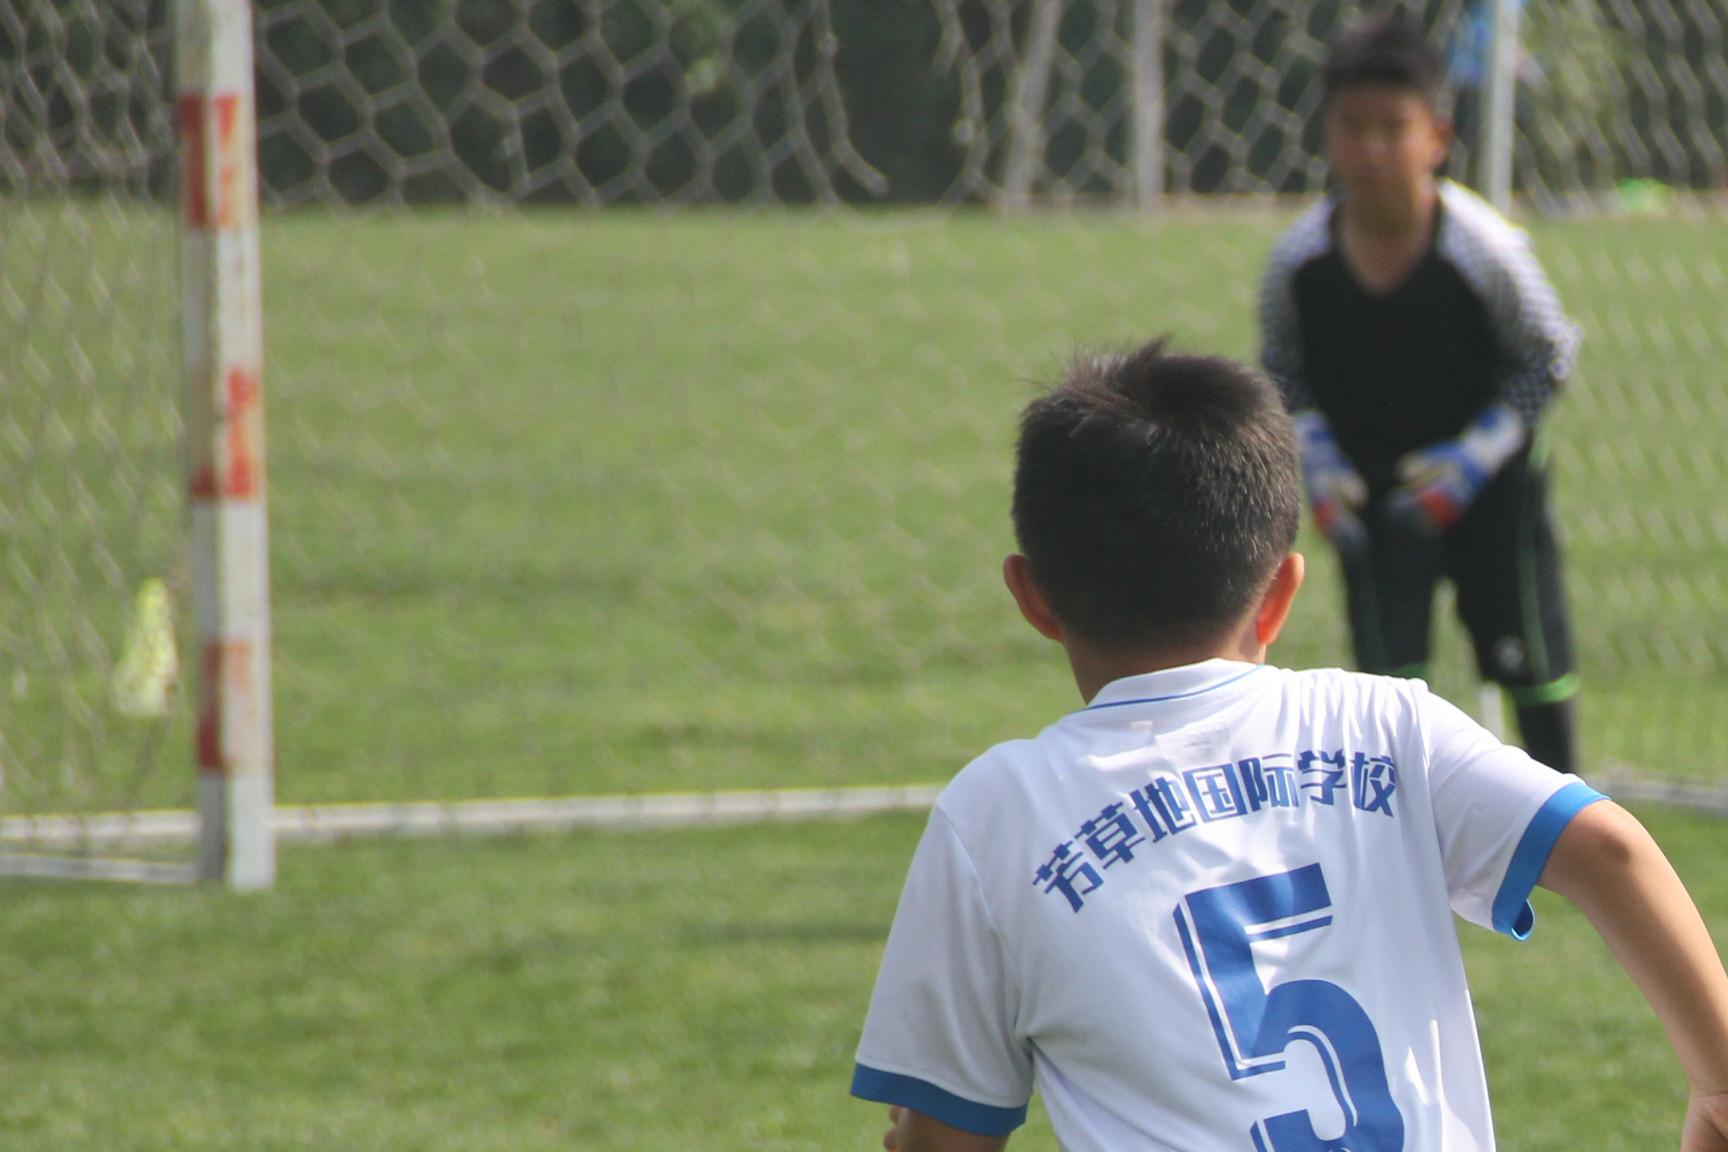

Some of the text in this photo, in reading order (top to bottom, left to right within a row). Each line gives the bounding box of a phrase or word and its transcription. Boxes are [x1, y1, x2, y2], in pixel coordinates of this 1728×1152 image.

[1032, 749, 1397, 913] 芳草地国际学校
